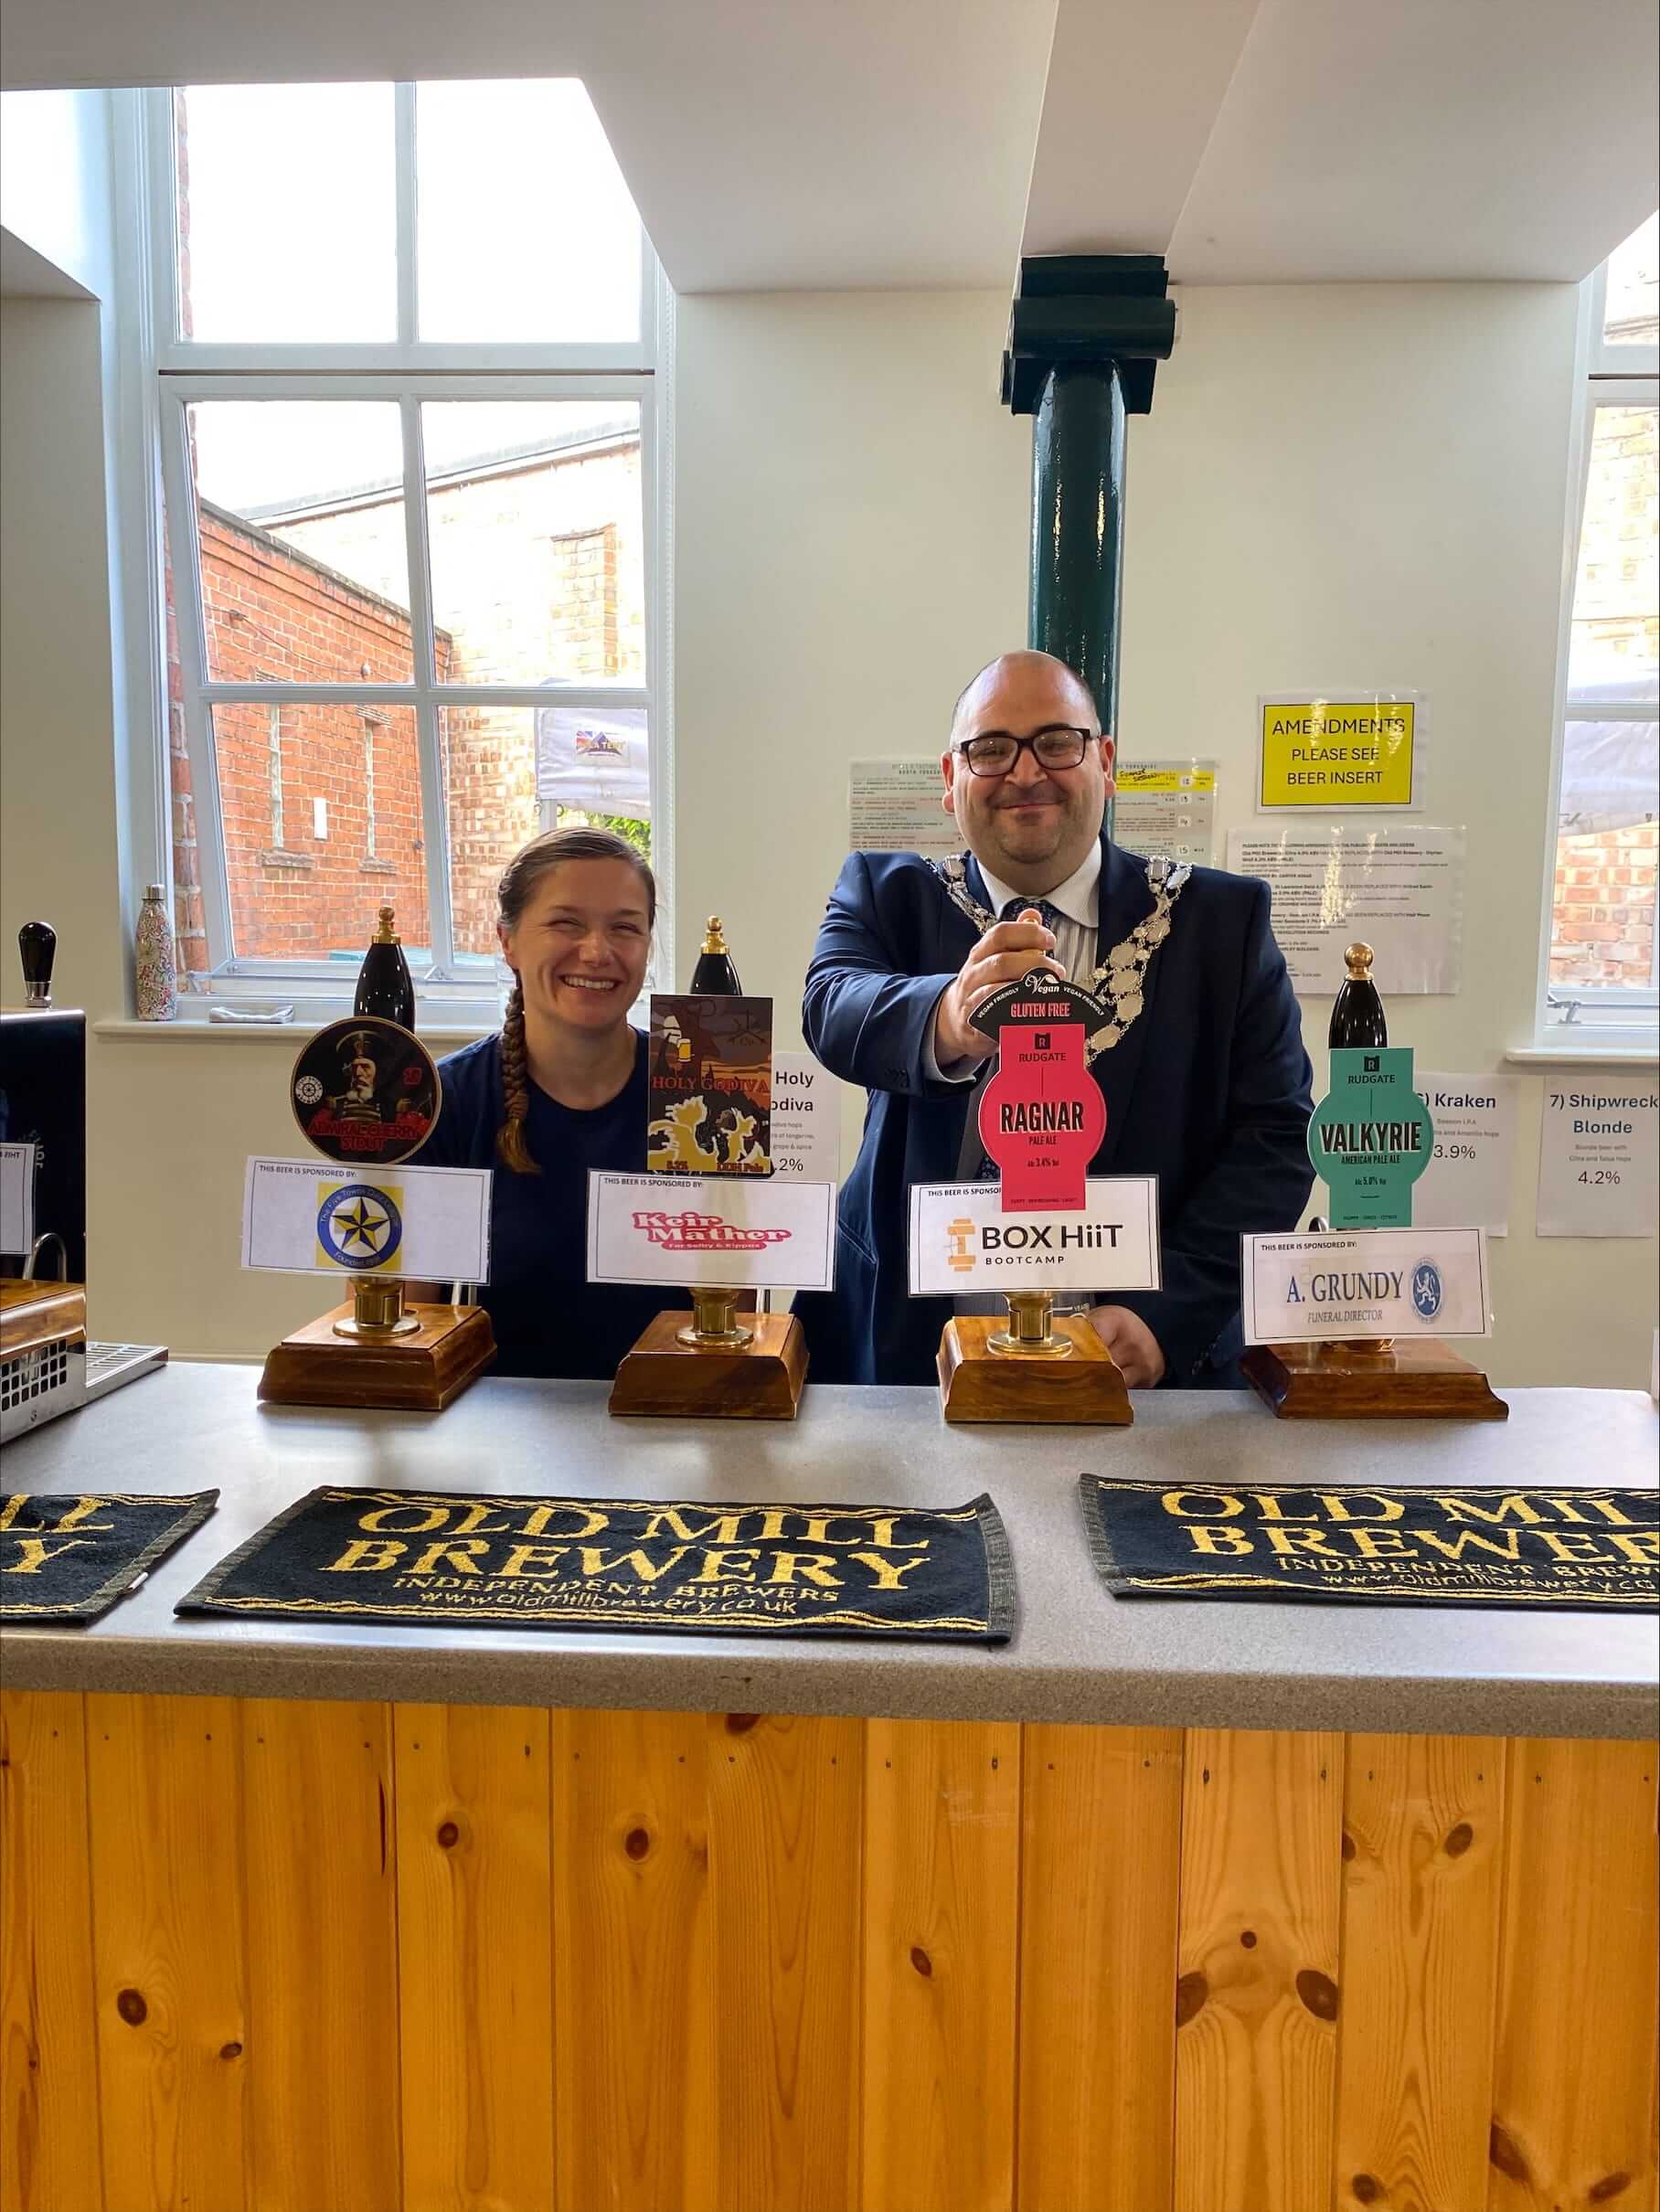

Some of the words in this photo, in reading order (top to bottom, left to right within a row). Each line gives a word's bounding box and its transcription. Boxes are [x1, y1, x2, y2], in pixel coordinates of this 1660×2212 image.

[1272, 718, 1405, 735] AMENDMENTS
[1292, 748, 1347, 760] PLEASE
[1352, 748, 1379, 760] SEE
[1287, 771, 1326, 784] BEER
[1330, 771, 1383, 784] INSERT
[1025, 973, 1060, 994] Vegan
[977, 1002, 995, 1018] VEGAN
[993, 987, 1019, 1006] FRIENDLY
[1063, 986, 1082, 998] VEGAN
[1081, 994, 1105, 1016] FRIENDLY
[1010, 1003, 1046, 1017] GLUTEN
[1047, 1002, 1070, 1017] FREE
[1038, 1037, 1047, 1048] R
[1018, 1052, 1067, 1062] RUDGATE
[1367, 1059, 1375, 1070] R
[652, 1076, 697, 1090] HOLY
[701, 1077, 770, 1092] GODIVA
[775, 1071, 814, 1089] Holy
[1347, 1074, 1396, 1084] RUDGATE
[771, 1098, 814, 1111] odiva
[1435, 1093, 1495, 1109] Kraken
[1549, 1094, 1565, 1111] 7)
[1569, 1094, 1659, 1111] Shipwreck
[1000, 1101, 1084, 1134] RAGNAR
[1573, 1121, 1633, 1134] Blonde
[342, 1136, 385, 1152] STOUT
[1028, 1135, 1045, 1145] PALE
[1046, 1135, 1057, 1145] ALE
[1319, 1122, 1422, 1154] VALKYRIE
[1341, 1154, 1372, 1164] AMERICAN
[1374, 1154, 1388, 1164] PALE
[1389, 1154, 1400, 1164] ALE
[1433, 1144, 1476, 1159] 3.9%
[259, 1164, 275, 1173] THIS
[302, 1167, 343, 1177] SPONSORED
[344, 1170, 356, 1178] BY:
[774, 1157, 803, 1172] .2%
[648, 1179, 691, 1188] SPONSORED
[693, 1180, 703, 1188] BY:
[1578, 1170, 1621, 1185] 4.2%
[633, 1212, 723, 1228] Keir
[647, 1227, 792, 1243] Mather
[982, 1225, 1053, 1250] BOX
[1060, 1224, 1123, 1249] HiiT
[985, 1256, 1065, 1266] BOOTCAMP
[1286, 1275, 1305, 1303] A.
[1312, 1271, 1404, 1303] GRUNDY
[1308, 1311, 1344, 1324] FUNERAL
[1344, 1309, 1383, 1323] DIRECTOR
[0, 1494, 114, 1534] LL
[1161, 1491, 1406, 1522] OLD
[1425, 1494, 1659, 1526] MIL
[358, 1505, 611, 1539] OLD
[633, 1509, 931, 1549] MILL
[1178, 1524, 1659, 1564] BREWER
[318, 1538, 931, 1590] BREWERY
[1276, 1557, 1534, 1575] INDEPENDENT
[1552, 1564, 1659, 1578] BREW
[392, 1576, 658, 1596] INDEPENDENT
[673, 1583, 839, 1601] BREWERS
